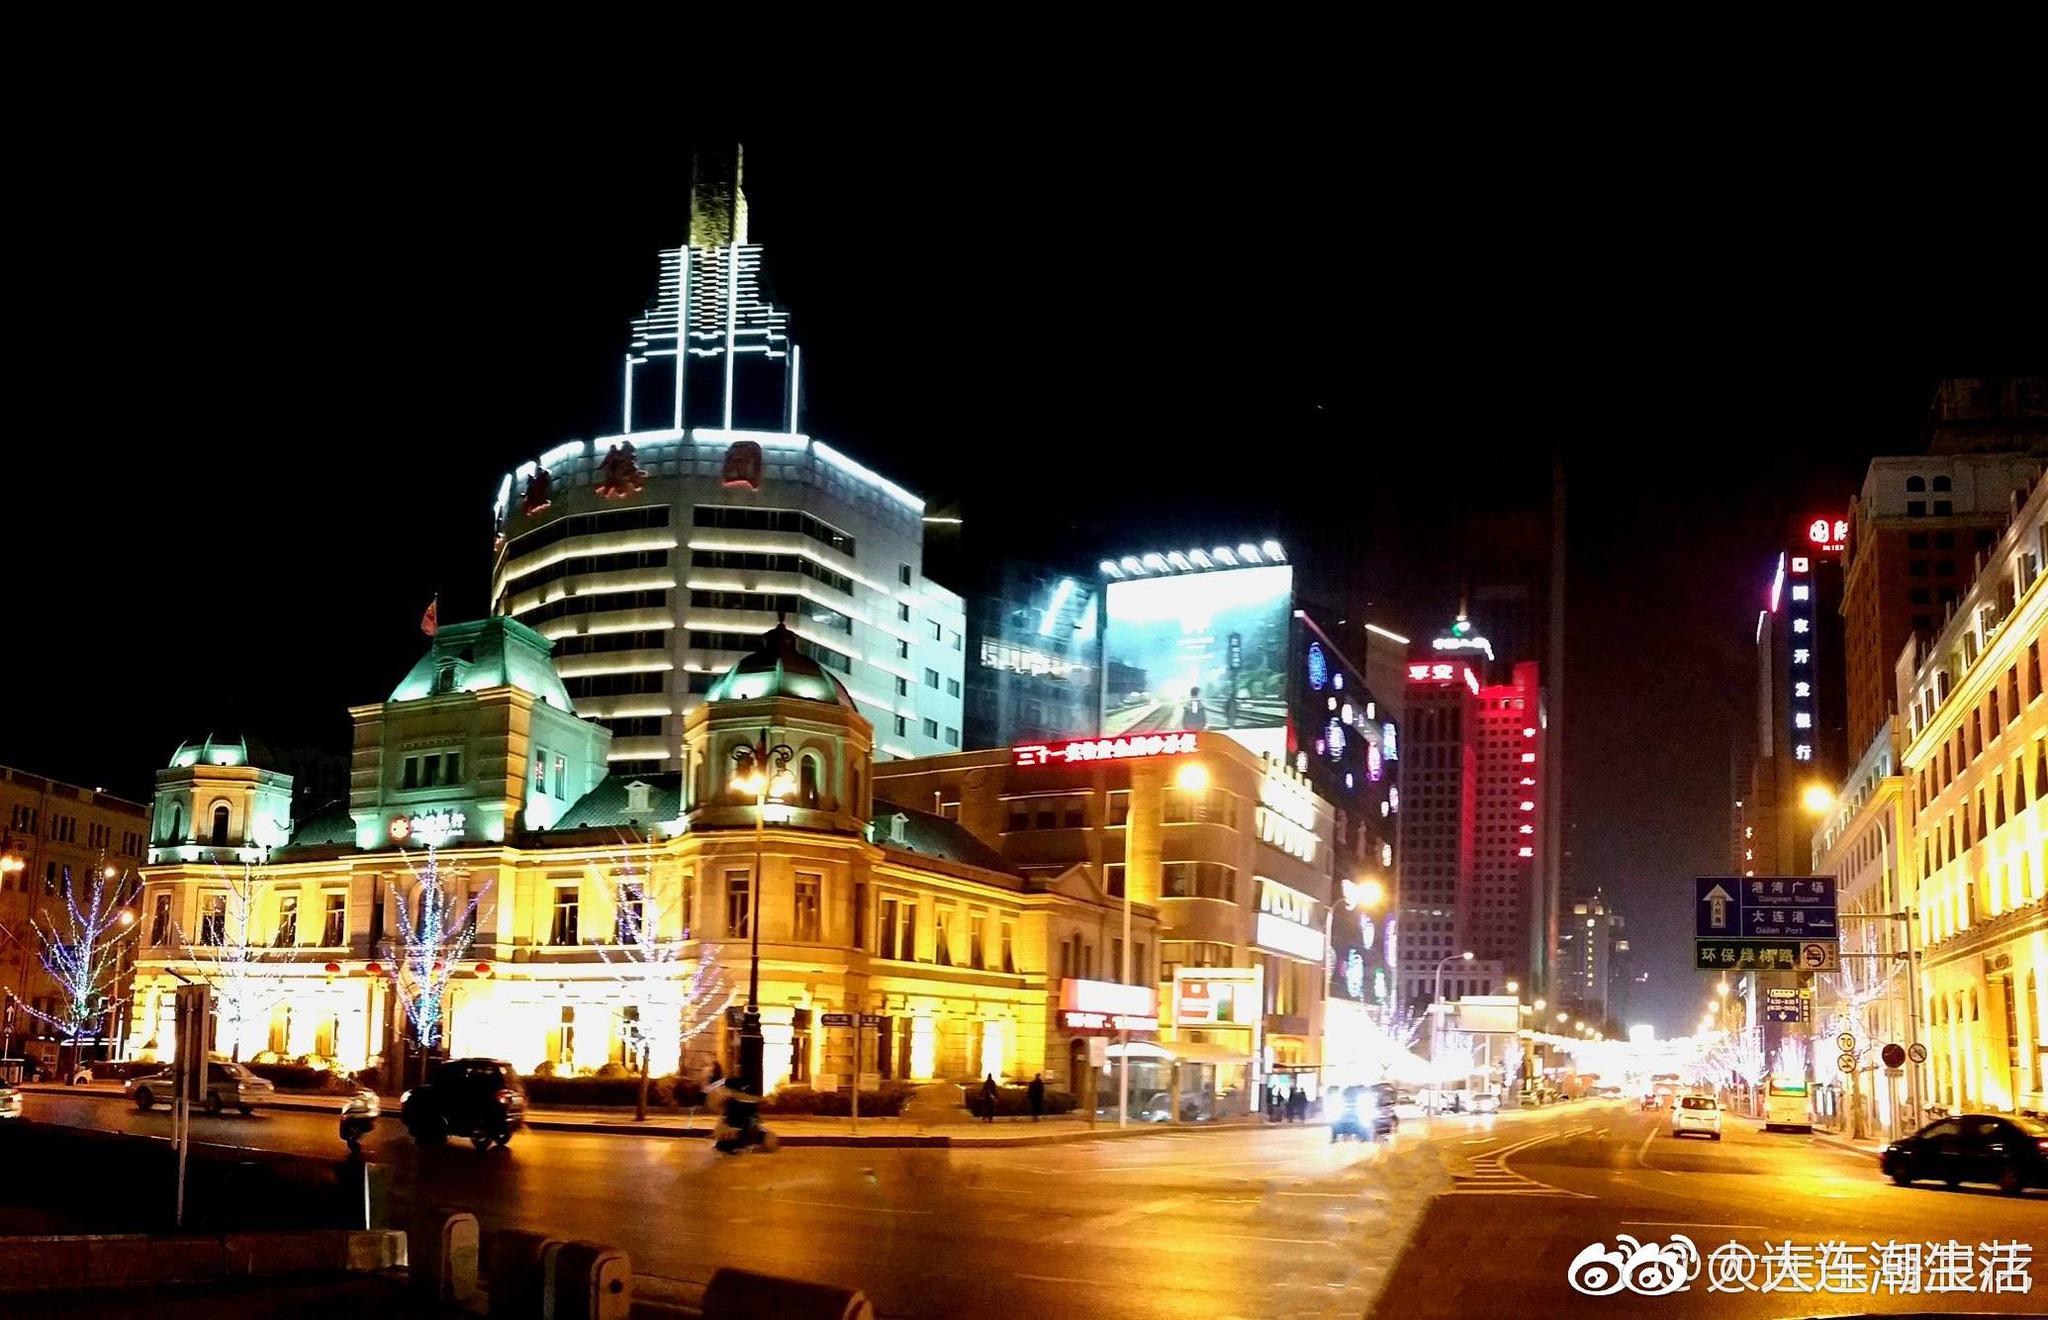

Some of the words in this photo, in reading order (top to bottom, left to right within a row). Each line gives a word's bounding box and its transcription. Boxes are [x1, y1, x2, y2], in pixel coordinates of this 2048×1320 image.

[1752, 881, 1824, 894] 港湾广场
[1752, 910, 1804, 923] 大连港
[1841, 1038, 1852, 1048] 70
